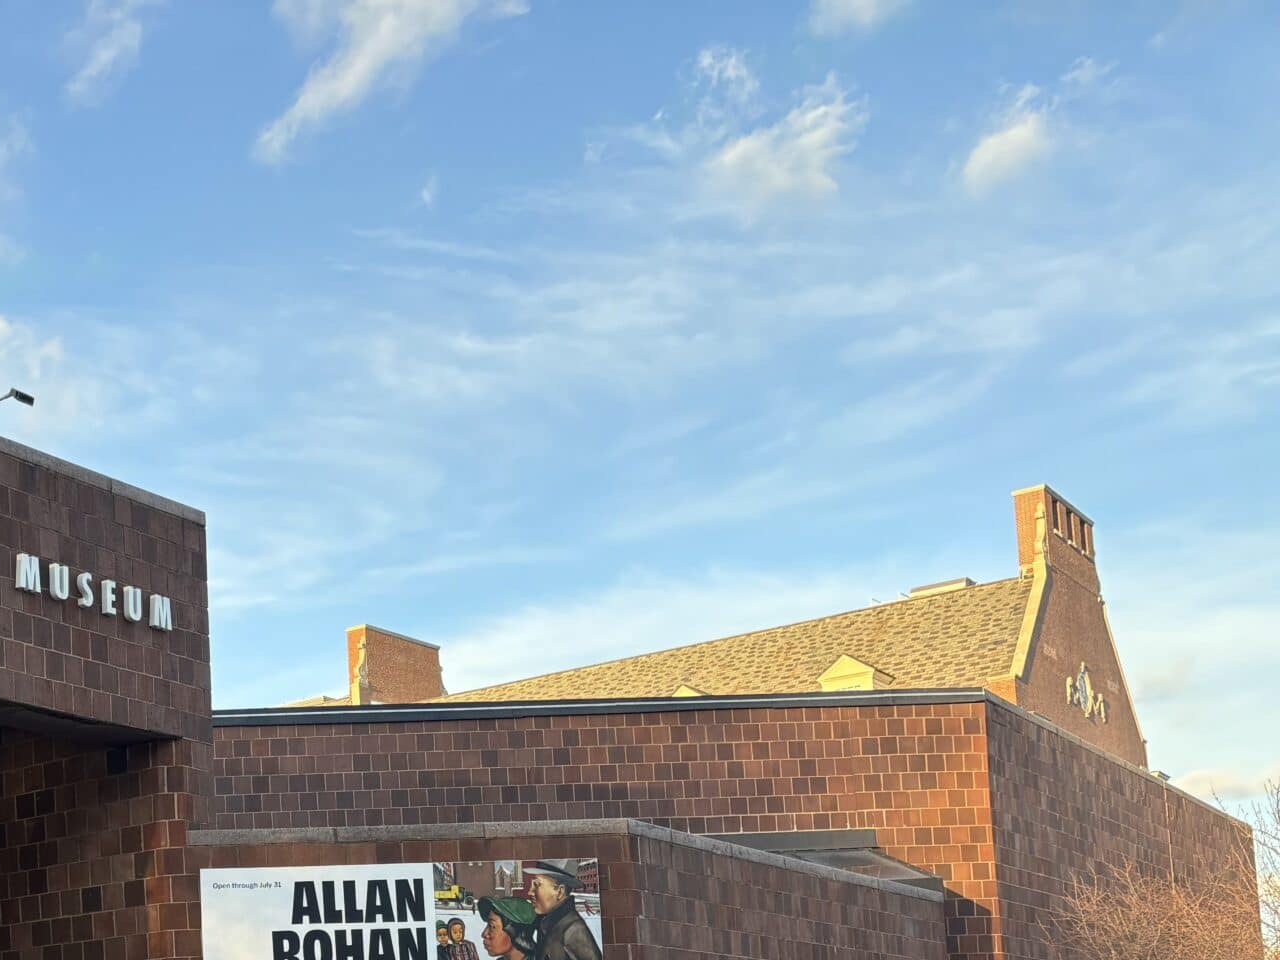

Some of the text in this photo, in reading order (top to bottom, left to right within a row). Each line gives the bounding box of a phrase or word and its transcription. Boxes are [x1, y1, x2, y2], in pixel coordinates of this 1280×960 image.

[15, 551, 174, 632] MUSEUM
[212, 882, 231, 890] Open
[231, 881, 259, 890] through
[259, 880, 273, 889] July
[291, 878, 426, 925] ALLAN
